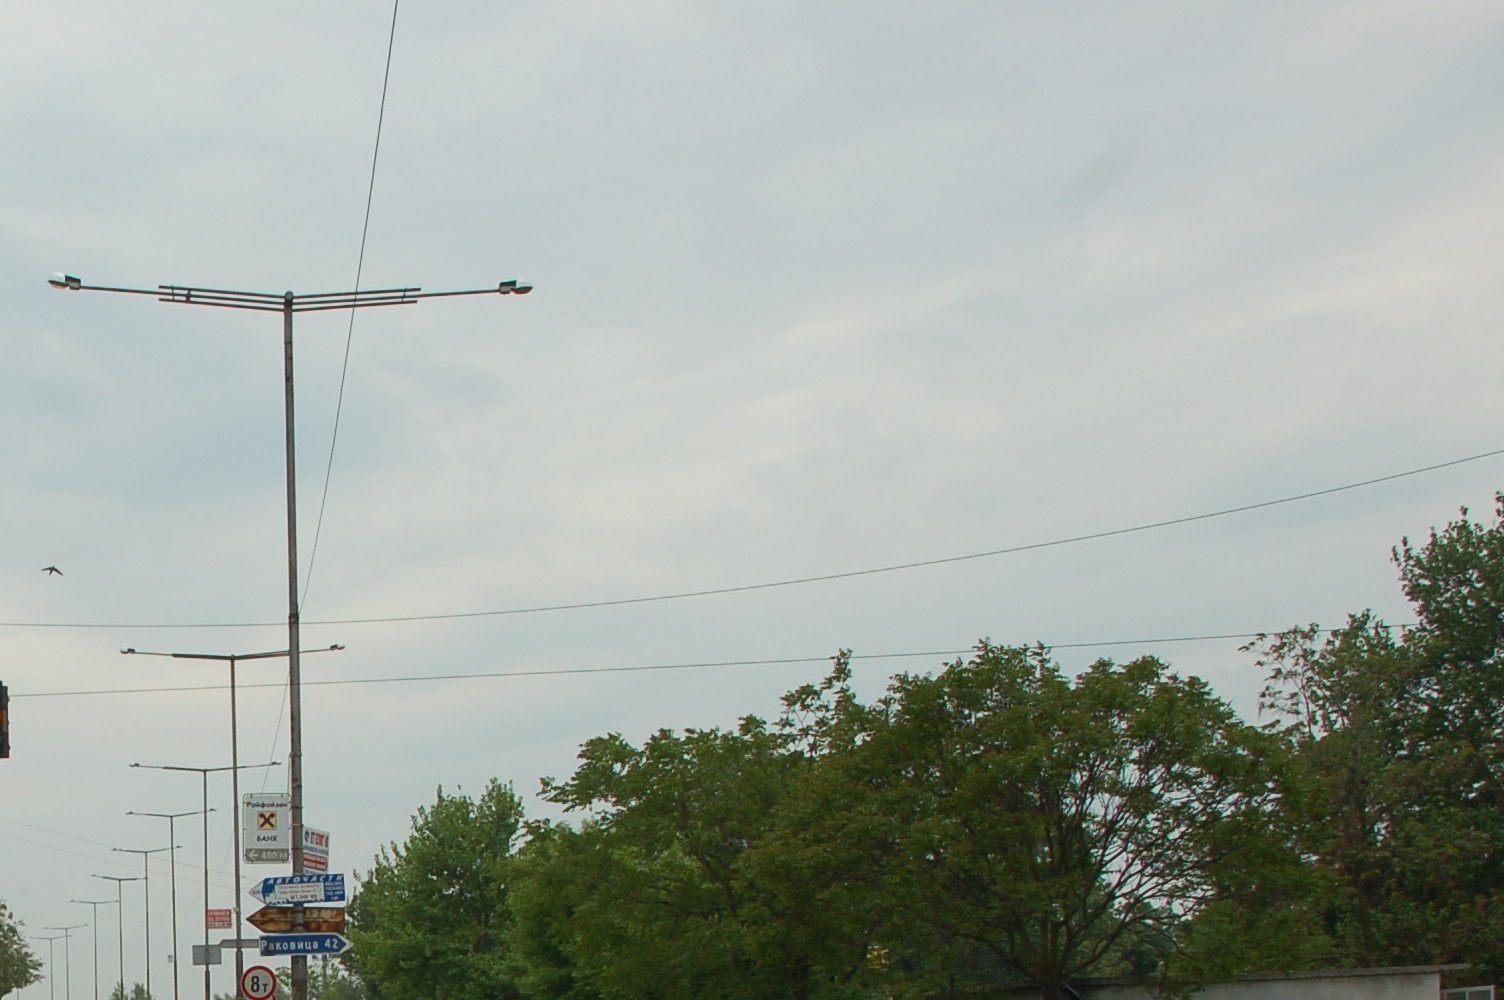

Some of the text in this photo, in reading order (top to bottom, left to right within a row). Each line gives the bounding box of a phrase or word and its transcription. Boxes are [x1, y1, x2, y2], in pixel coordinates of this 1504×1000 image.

[261, 850, 278, 860] 400
[267, 874, 343, 885] АВТОЧАСТИ
[261, 938, 338, 951] Раковица 42
